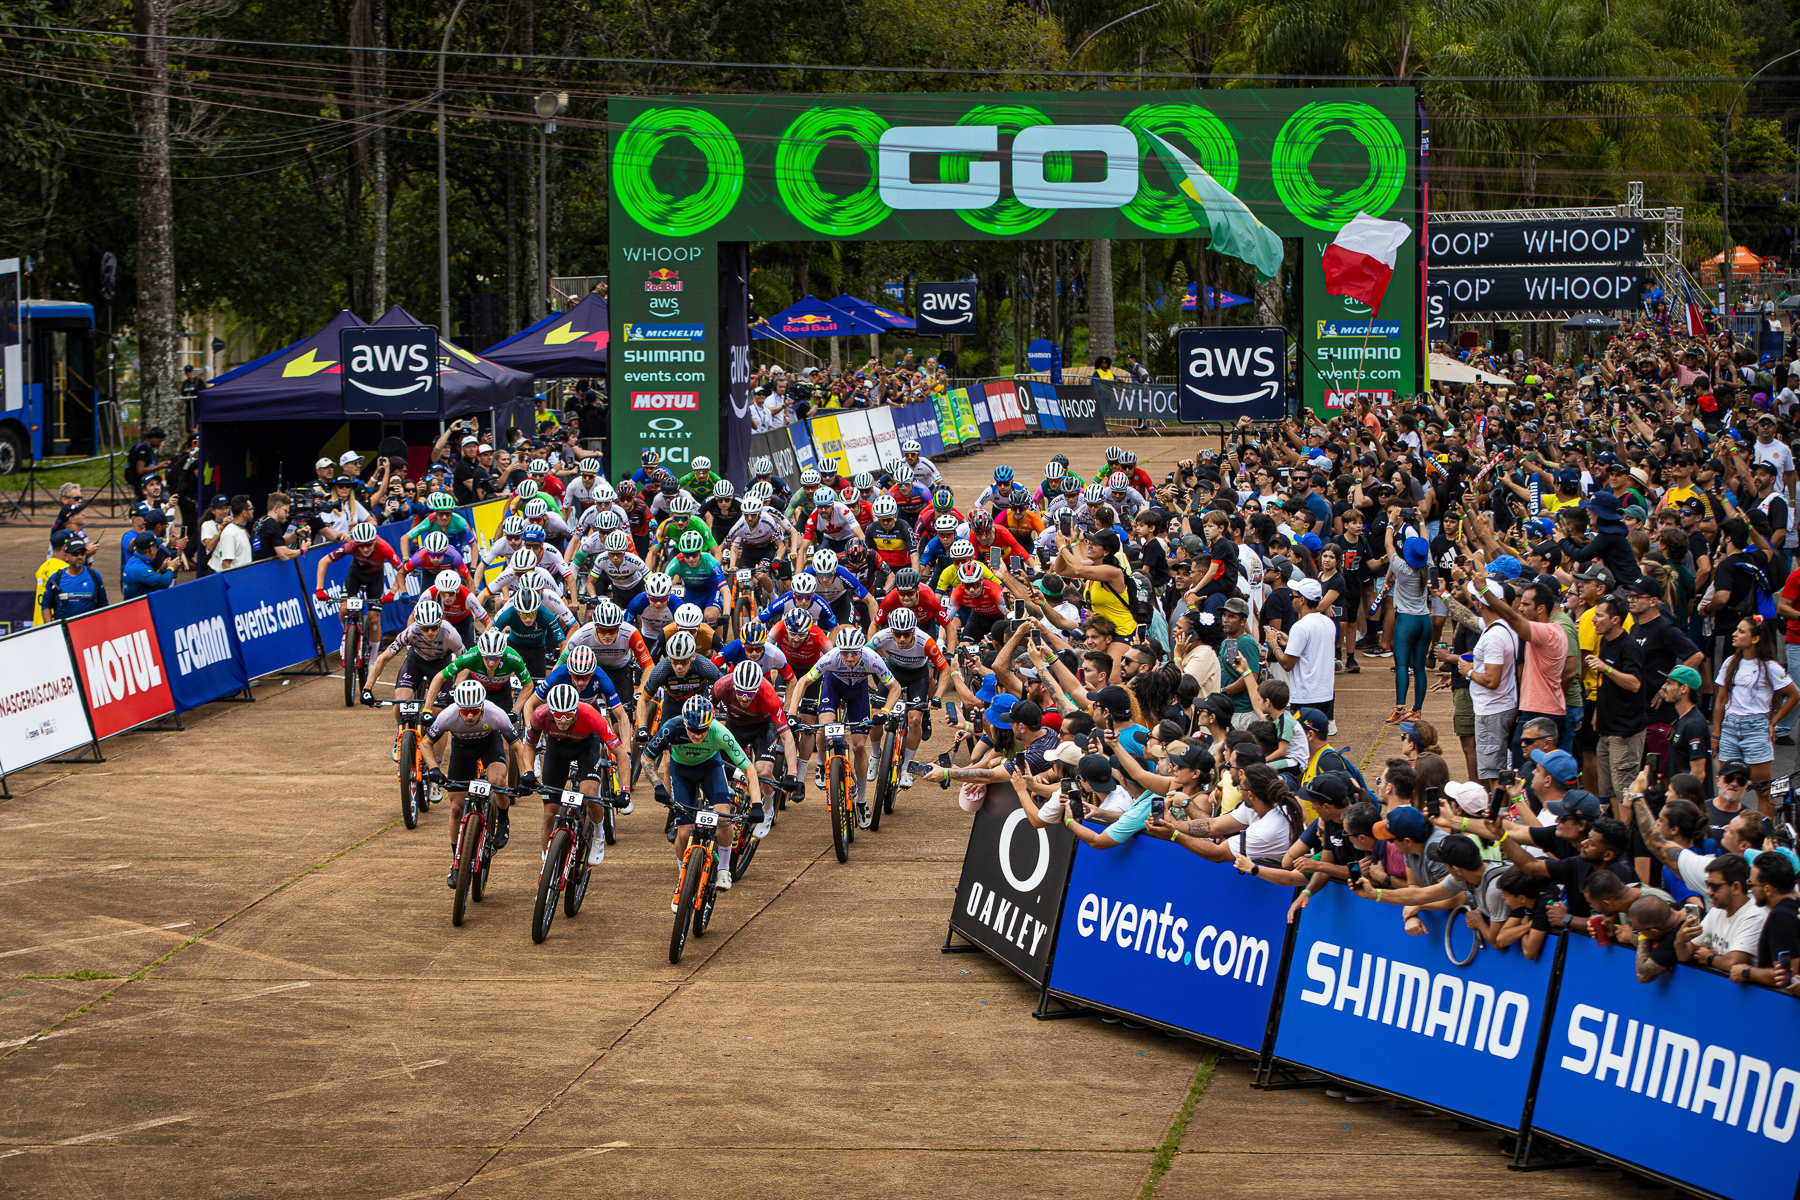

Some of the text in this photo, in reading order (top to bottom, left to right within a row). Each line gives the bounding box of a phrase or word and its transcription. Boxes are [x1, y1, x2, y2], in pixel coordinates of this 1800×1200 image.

[879, 124, 1139, 210] GO
[1523, 226, 1631, 254] WHOOP
[623, 247, 701, 262] WHOOP
[645, 281, 683, 291] Red Bull
[1524, 275, 1632, 301] WHOOP
[650, 297, 679, 309] aws
[922, 292, 971, 310] aws
[646, 329, 703, 337] MICHELIN
[783, 323, 838, 333] Red Bull
[351, 343, 429, 373] aws
[624, 350, 705, 363] SHIMANO
[1317, 347, 1401, 360] SHIMANO
[730, 345, 750, 384] aws
[1188, 347, 1276, 378] aws
[624, 371, 706, 382] events.com
[634, 394, 697, 408] MOTUL
[235, 597, 304, 643] events.com
[83, 629, 162, 710] MOTUL
[827, 726, 841, 734] 37
[473, 785, 486, 795] 10
[568, 795, 575, 803] 8
[700, 815, 714, 824] 69
[966, 881, 1044, 957] OAKLEY
[1077, 893, 1270, 987] events.com
[1301, 941, 1530, 1060] SHIMANO
[1561, 1003, 1800, 1144] SHIMANO
